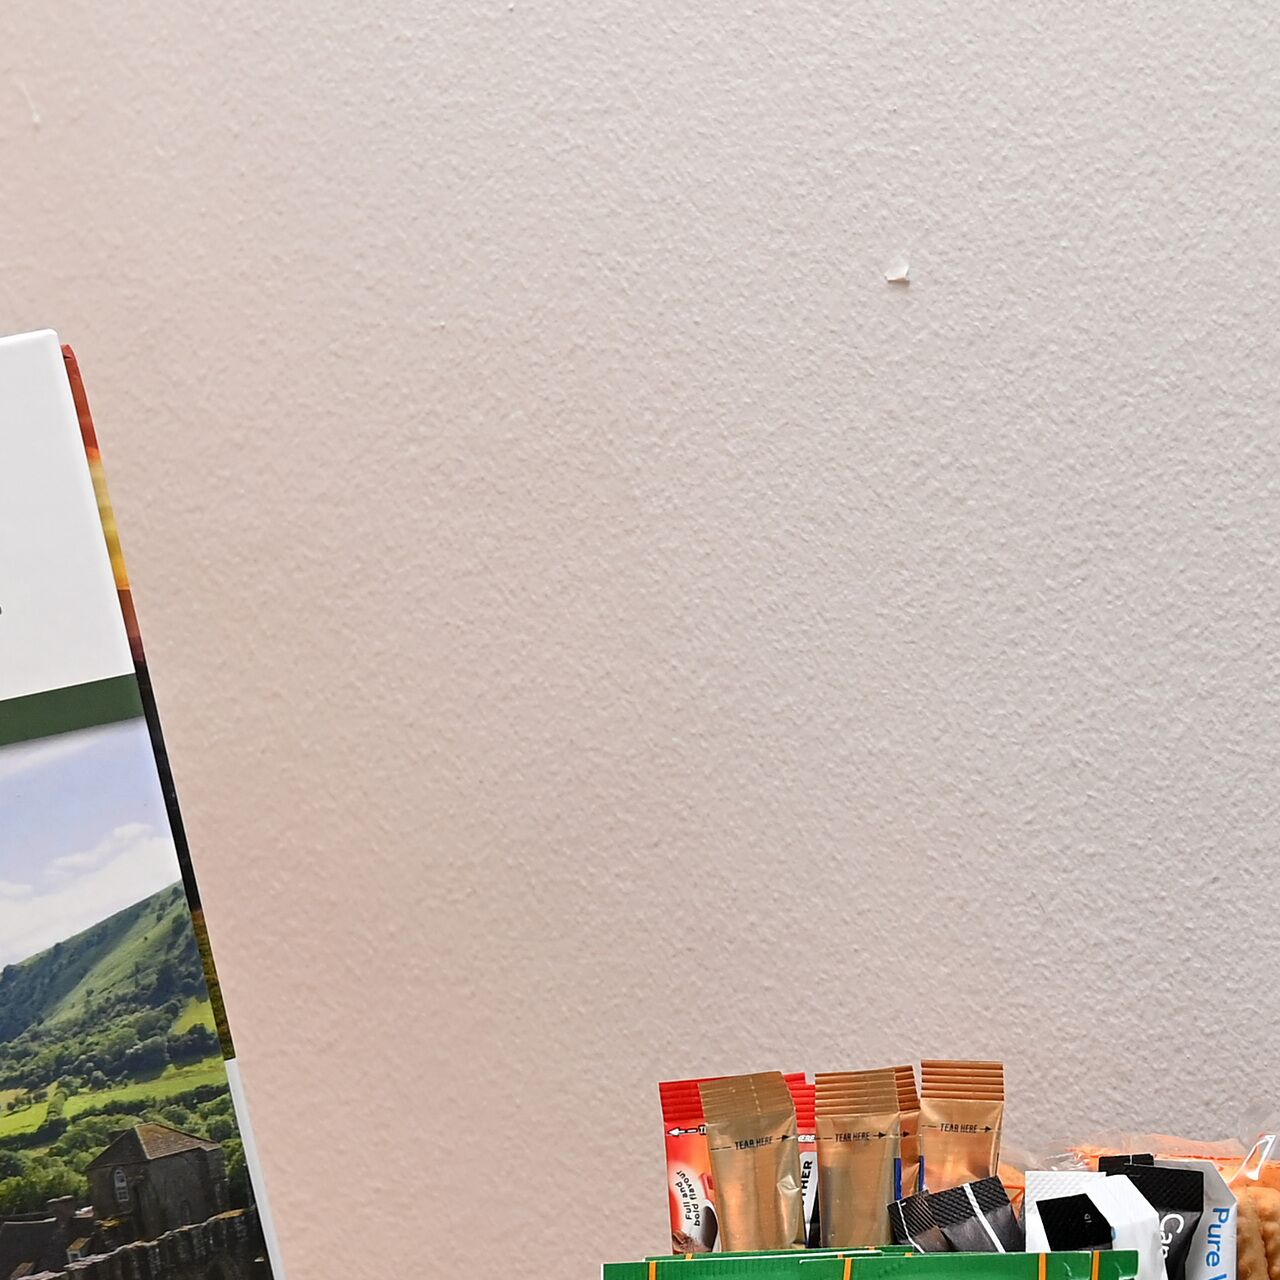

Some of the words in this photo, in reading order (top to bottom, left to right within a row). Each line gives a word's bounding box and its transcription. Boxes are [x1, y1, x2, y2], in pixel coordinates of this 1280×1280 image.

[835, 1133, 851, 1142] TEAR
[852, 1132, 870, 1141] HERE
[940, 1123, 959, 1132] TEAR
[960, 1124, 978, 1133] HERE
[734, 1139, 755, 1150] TEAR
[755, 1136, 773, 1147] HERE
[675, 1181, 688, 1198] and
[676, 1170, 697, 1201] flavour
[684, 1200, 692, 1220] Full
[692, 1203, 701, 1227] bold
[1205, 1207, 1230, 1267] Pure
